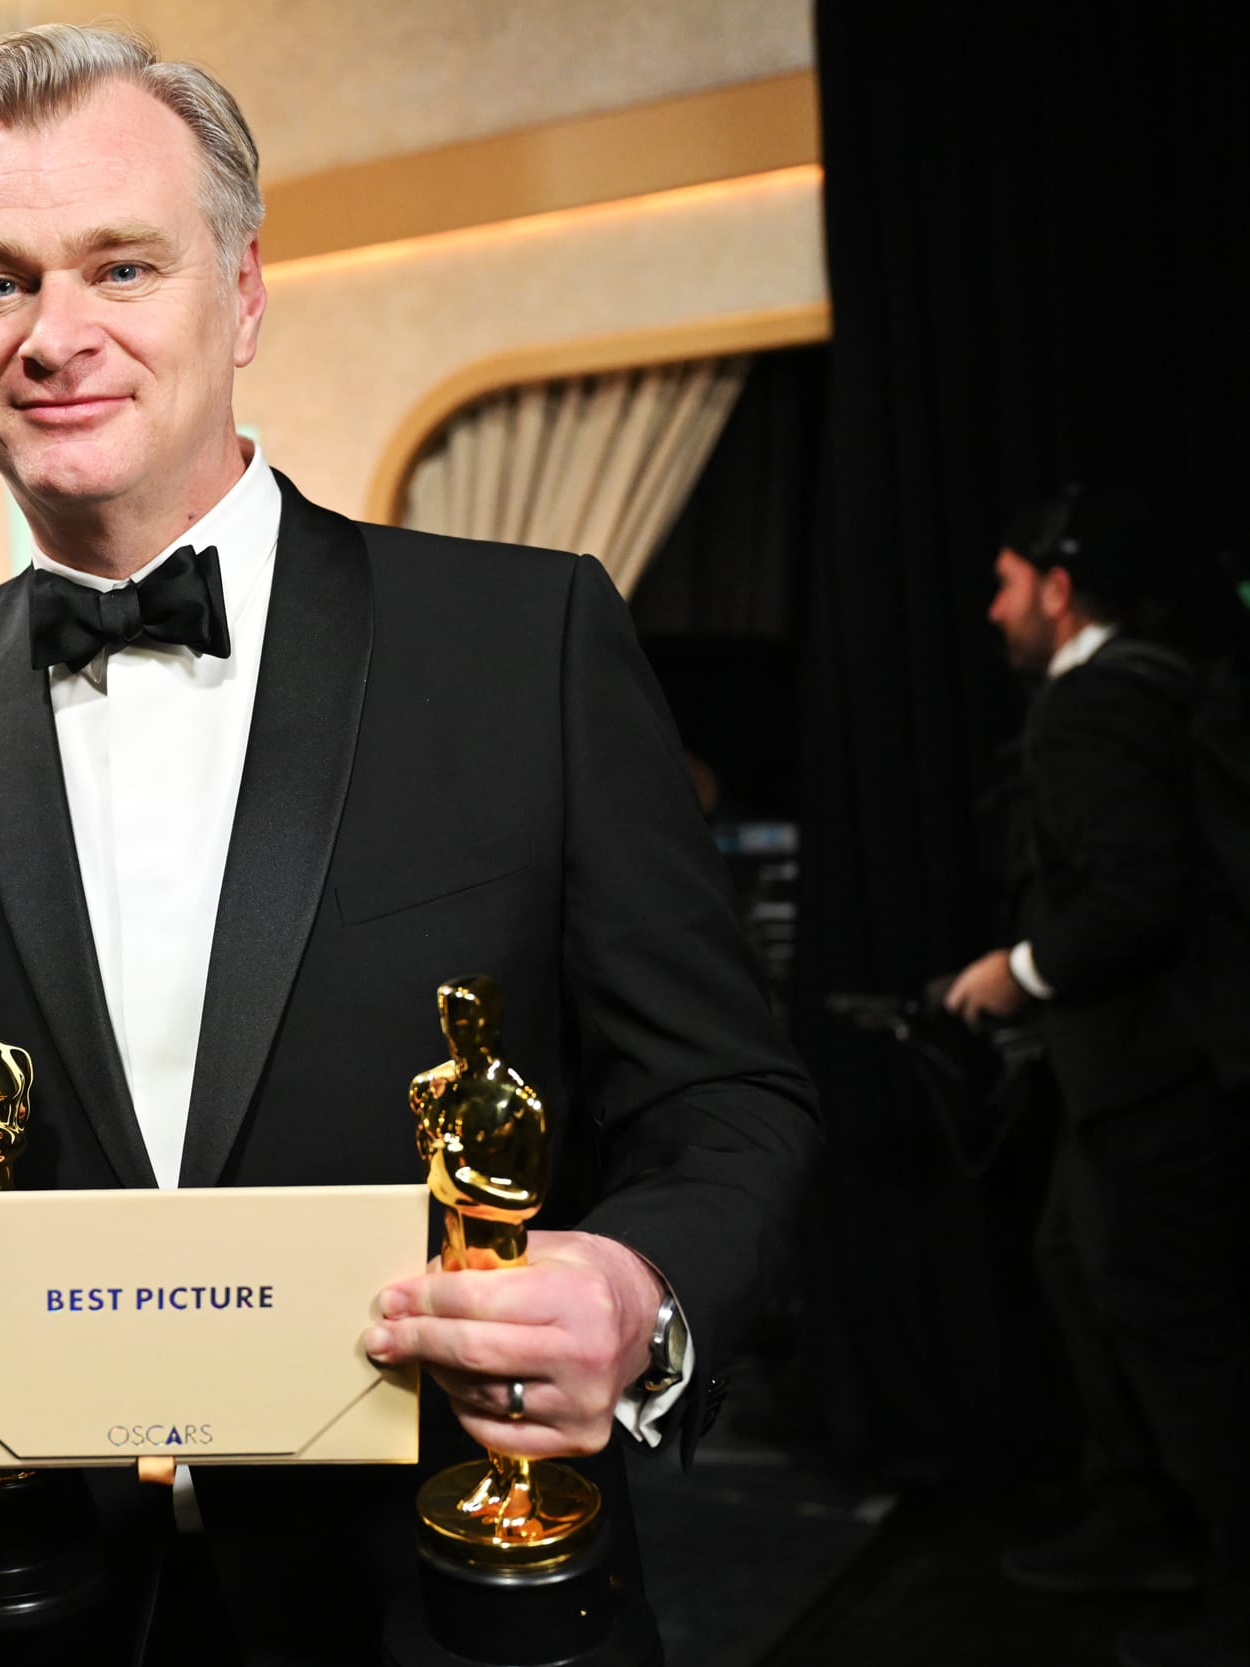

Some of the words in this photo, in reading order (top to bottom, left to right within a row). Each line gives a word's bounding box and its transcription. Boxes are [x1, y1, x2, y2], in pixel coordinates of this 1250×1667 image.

[46, 1288, 123, 1312] BEST
[136, 1285, 274, 1310] PICTURE
[107, 1424, 213, 1447] OSCARS
